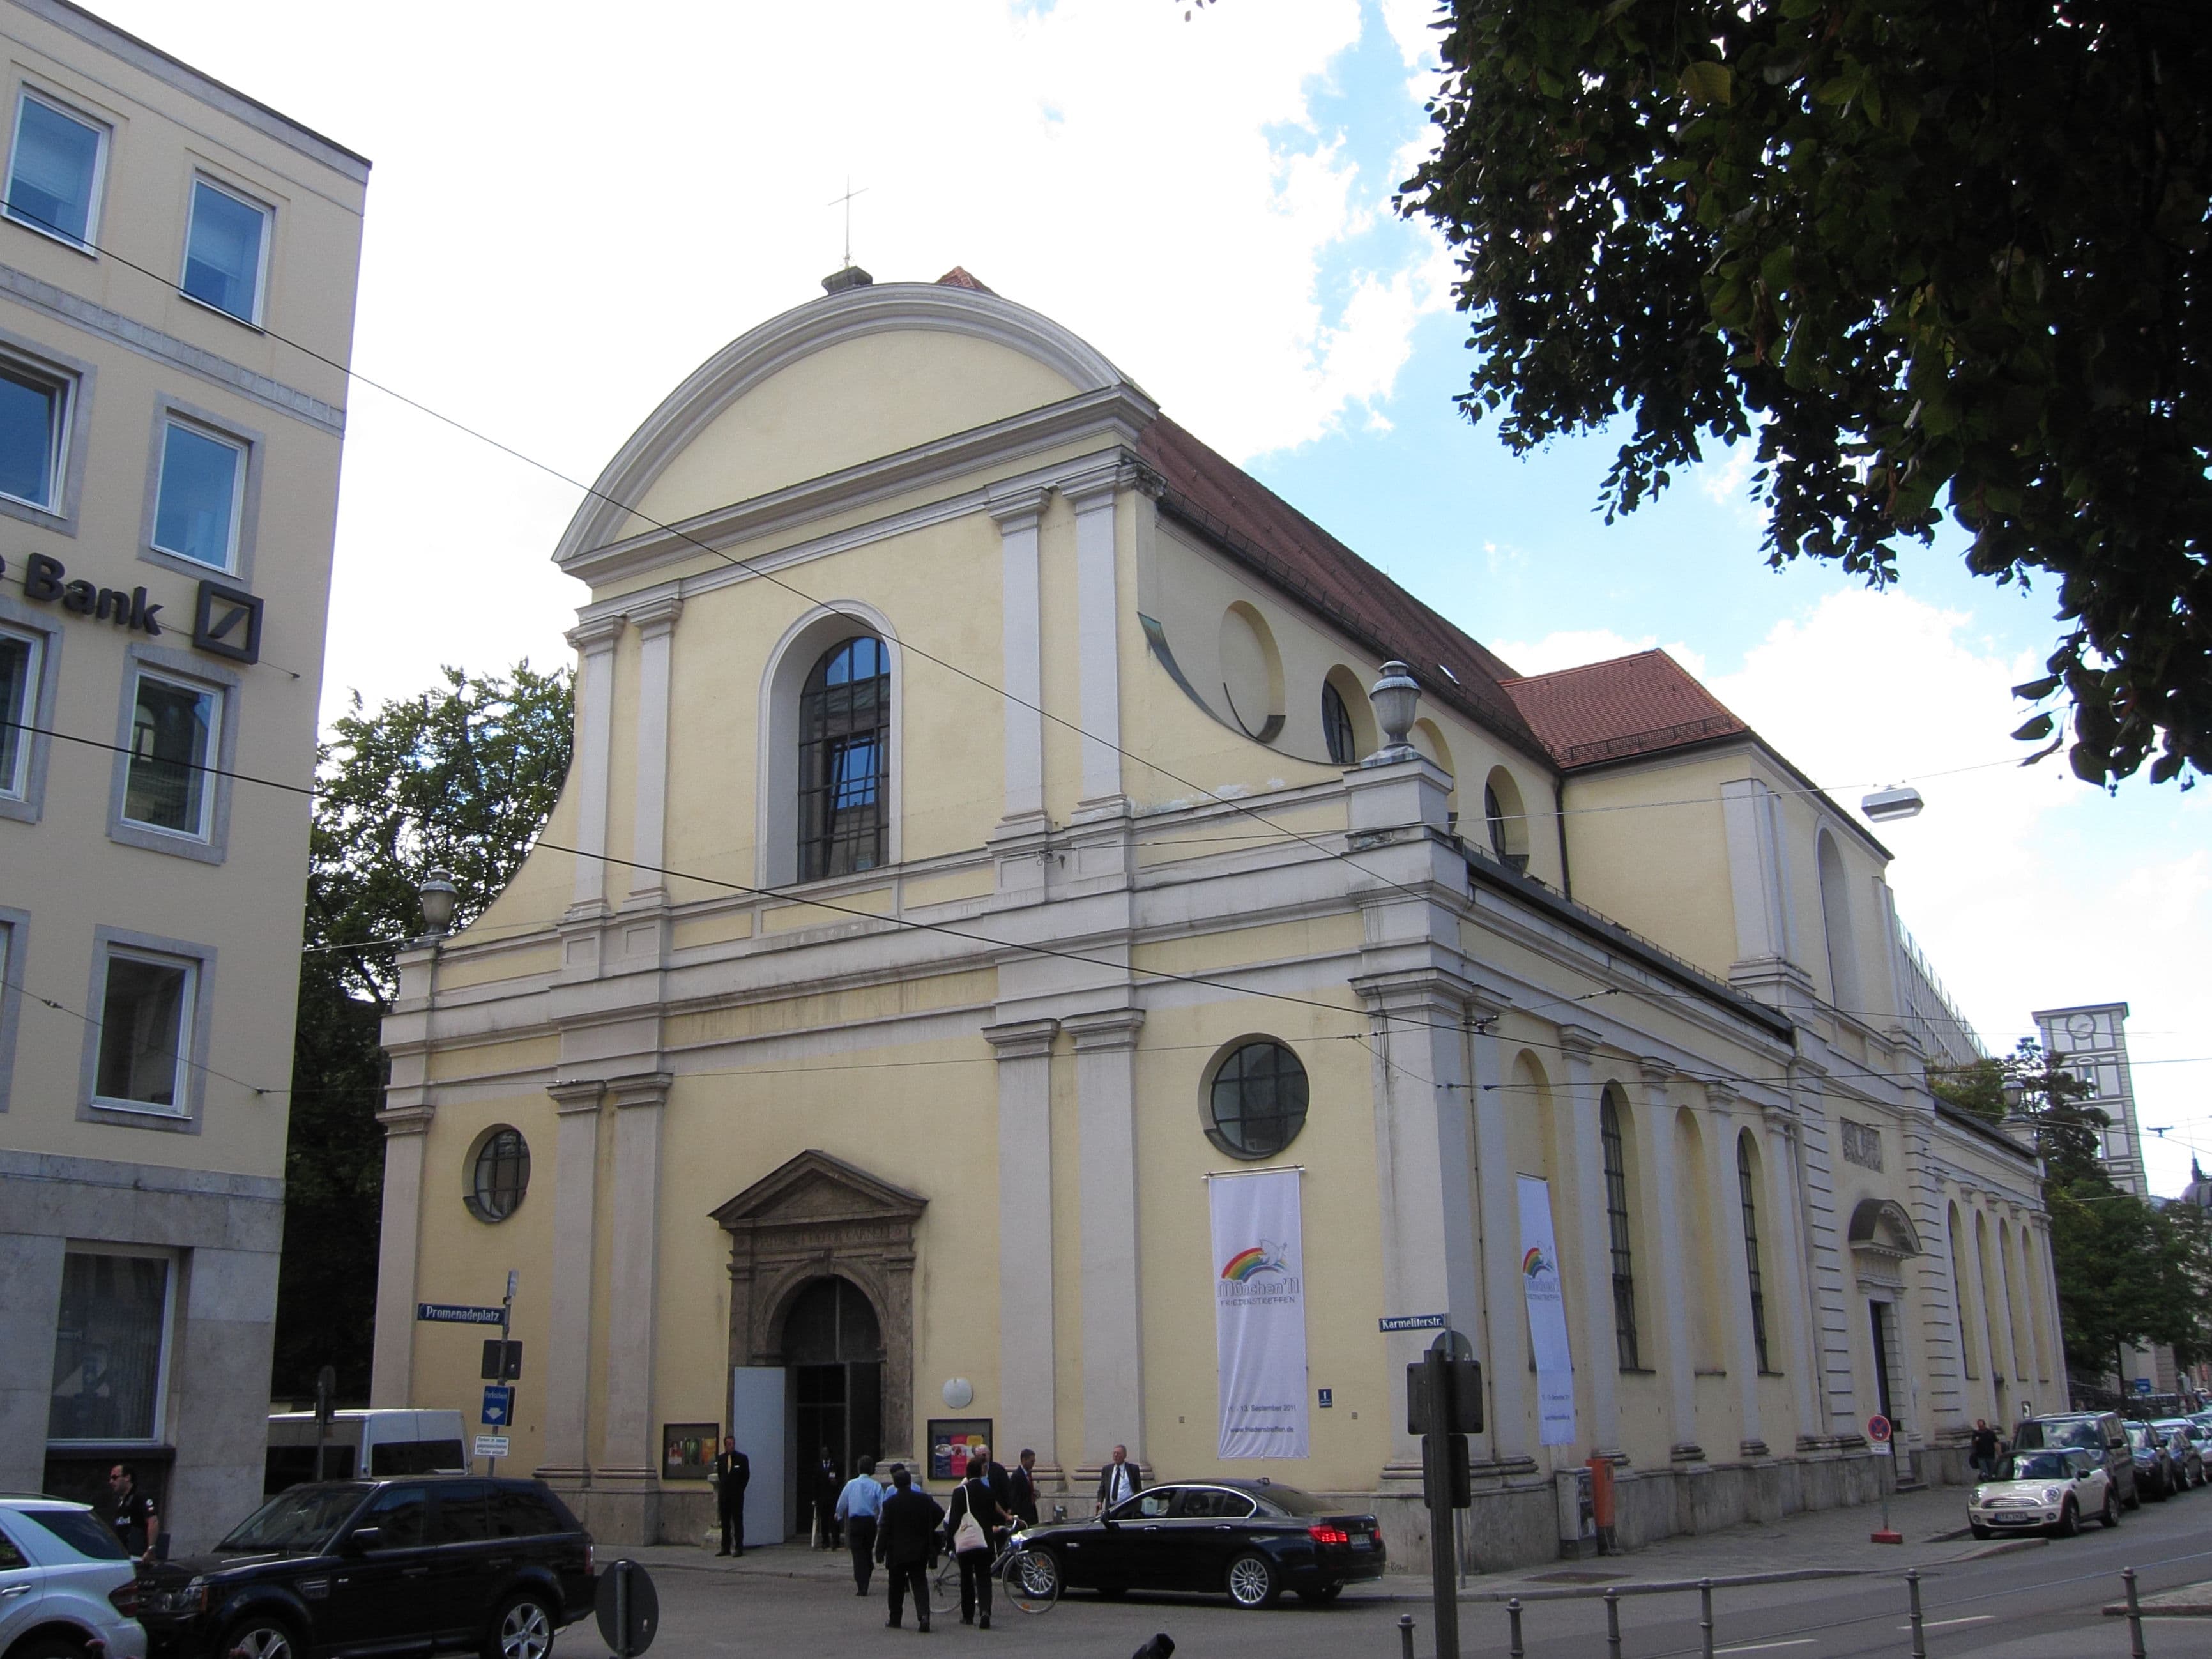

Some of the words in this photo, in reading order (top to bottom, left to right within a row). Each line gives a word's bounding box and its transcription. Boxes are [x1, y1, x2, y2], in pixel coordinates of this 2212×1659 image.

[24, 552, 164, 636] Bank
[1221, 1296, 1295, 1306] FRIEDENSTREFFEN
[426, 1306, 500, 1322] Promenadeplatz
[1382, 1317, 1442, 1329] Karmeliterstr.
